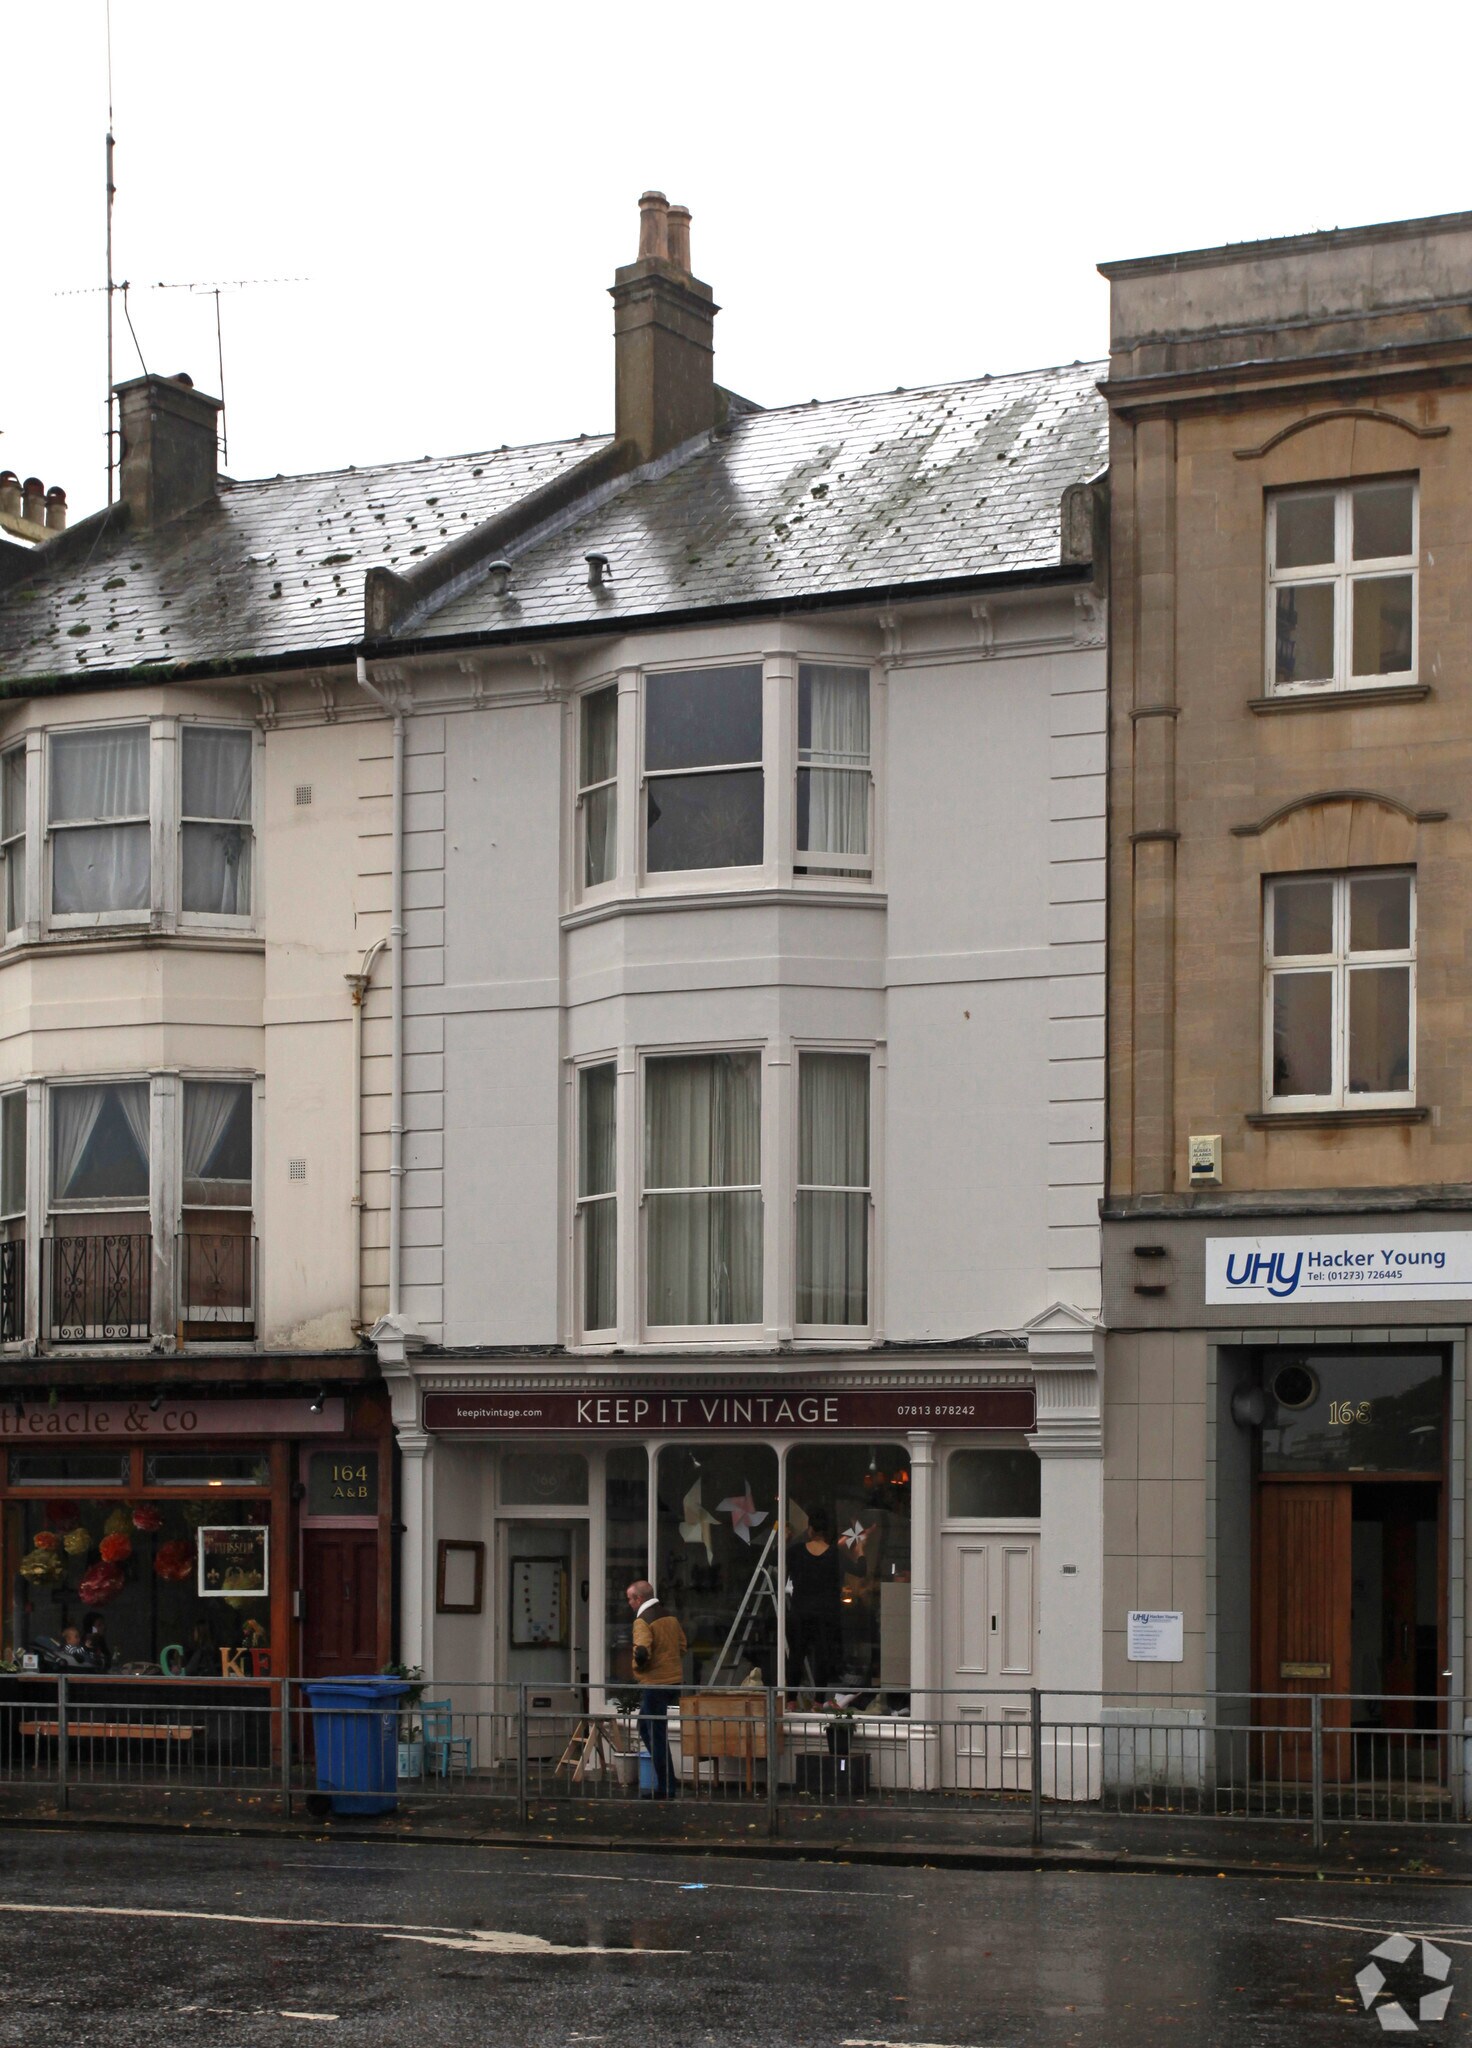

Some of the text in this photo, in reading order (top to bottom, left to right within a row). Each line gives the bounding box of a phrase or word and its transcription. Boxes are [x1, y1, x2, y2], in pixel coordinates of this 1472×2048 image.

[1308, 1251, 1375, 1268] Hacker
[1381, 1249, 1446, 1269] Young
[1307, 1269, 1403, 1282] Tel: (01273) 726445
[0, 1402, 198, 1434] treacle & co
[456, 1407, 543, 1419] keepitvintage.com
[577, 1397, 839, 1423] KEEP IT VINTAGE
[896, 1405, 976, 1416] 07813 878242
[1328, 1401, 1372, 1425] 168
[332, 1465, 368, 1482] 164
